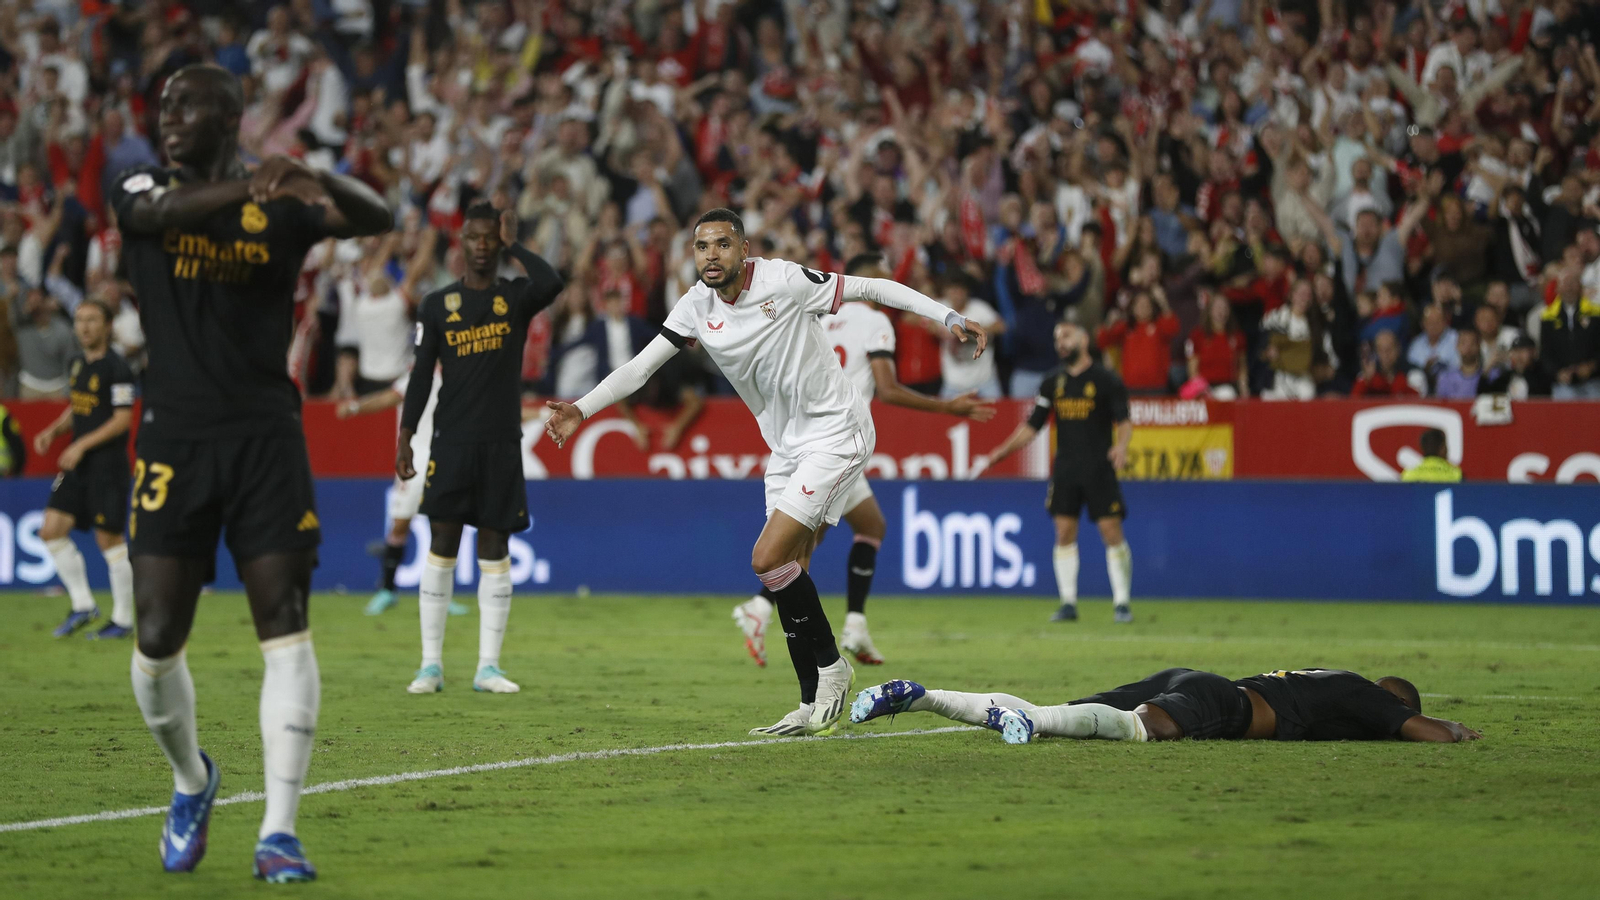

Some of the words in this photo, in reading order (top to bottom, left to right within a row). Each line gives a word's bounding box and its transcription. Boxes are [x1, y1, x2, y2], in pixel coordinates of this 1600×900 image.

[445, 322, 511, 347] Emirates
[903, 485, 1036, 590] bms.
[1435, 487, 1600, 597] bm
